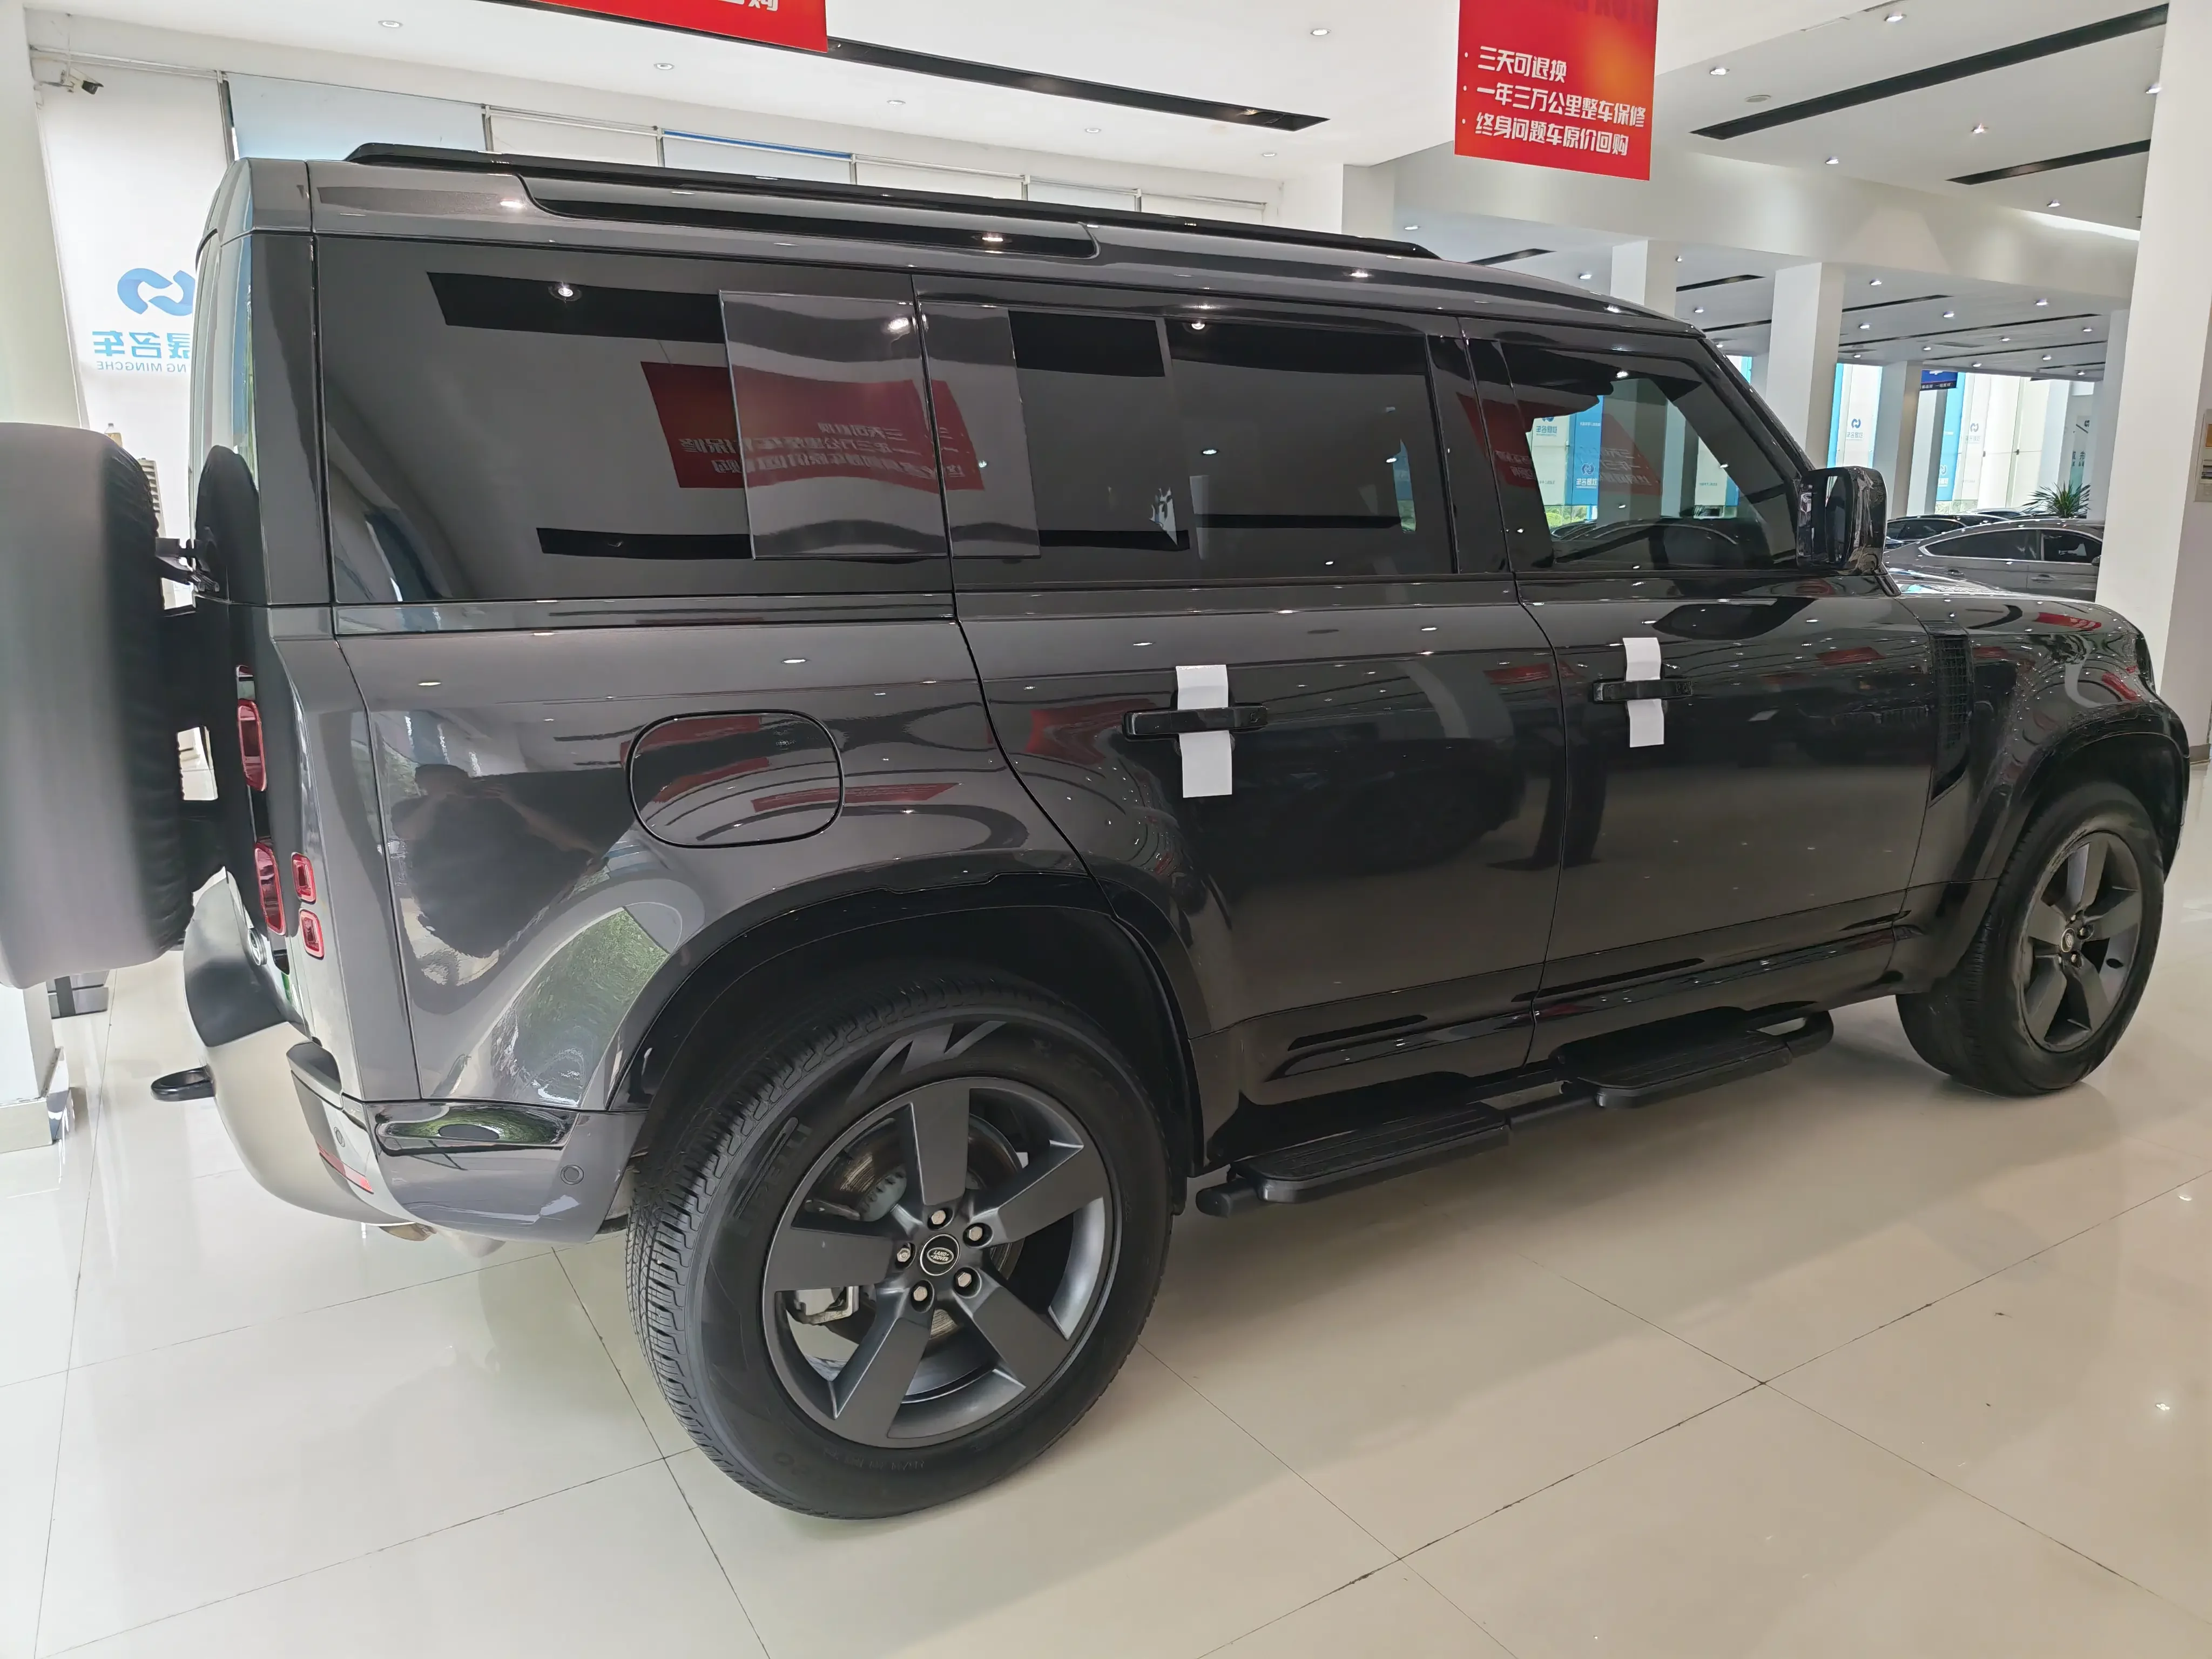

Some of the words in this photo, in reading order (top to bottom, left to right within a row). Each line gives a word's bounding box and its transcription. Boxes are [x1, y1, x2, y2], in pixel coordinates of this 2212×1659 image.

[1478, 45, 1567, 83] 三天可退换
[1476, 82, 1647, 128] 一年三万公里整车保修
[1475, 112, 1629, 156] 终身问题车原价回购
